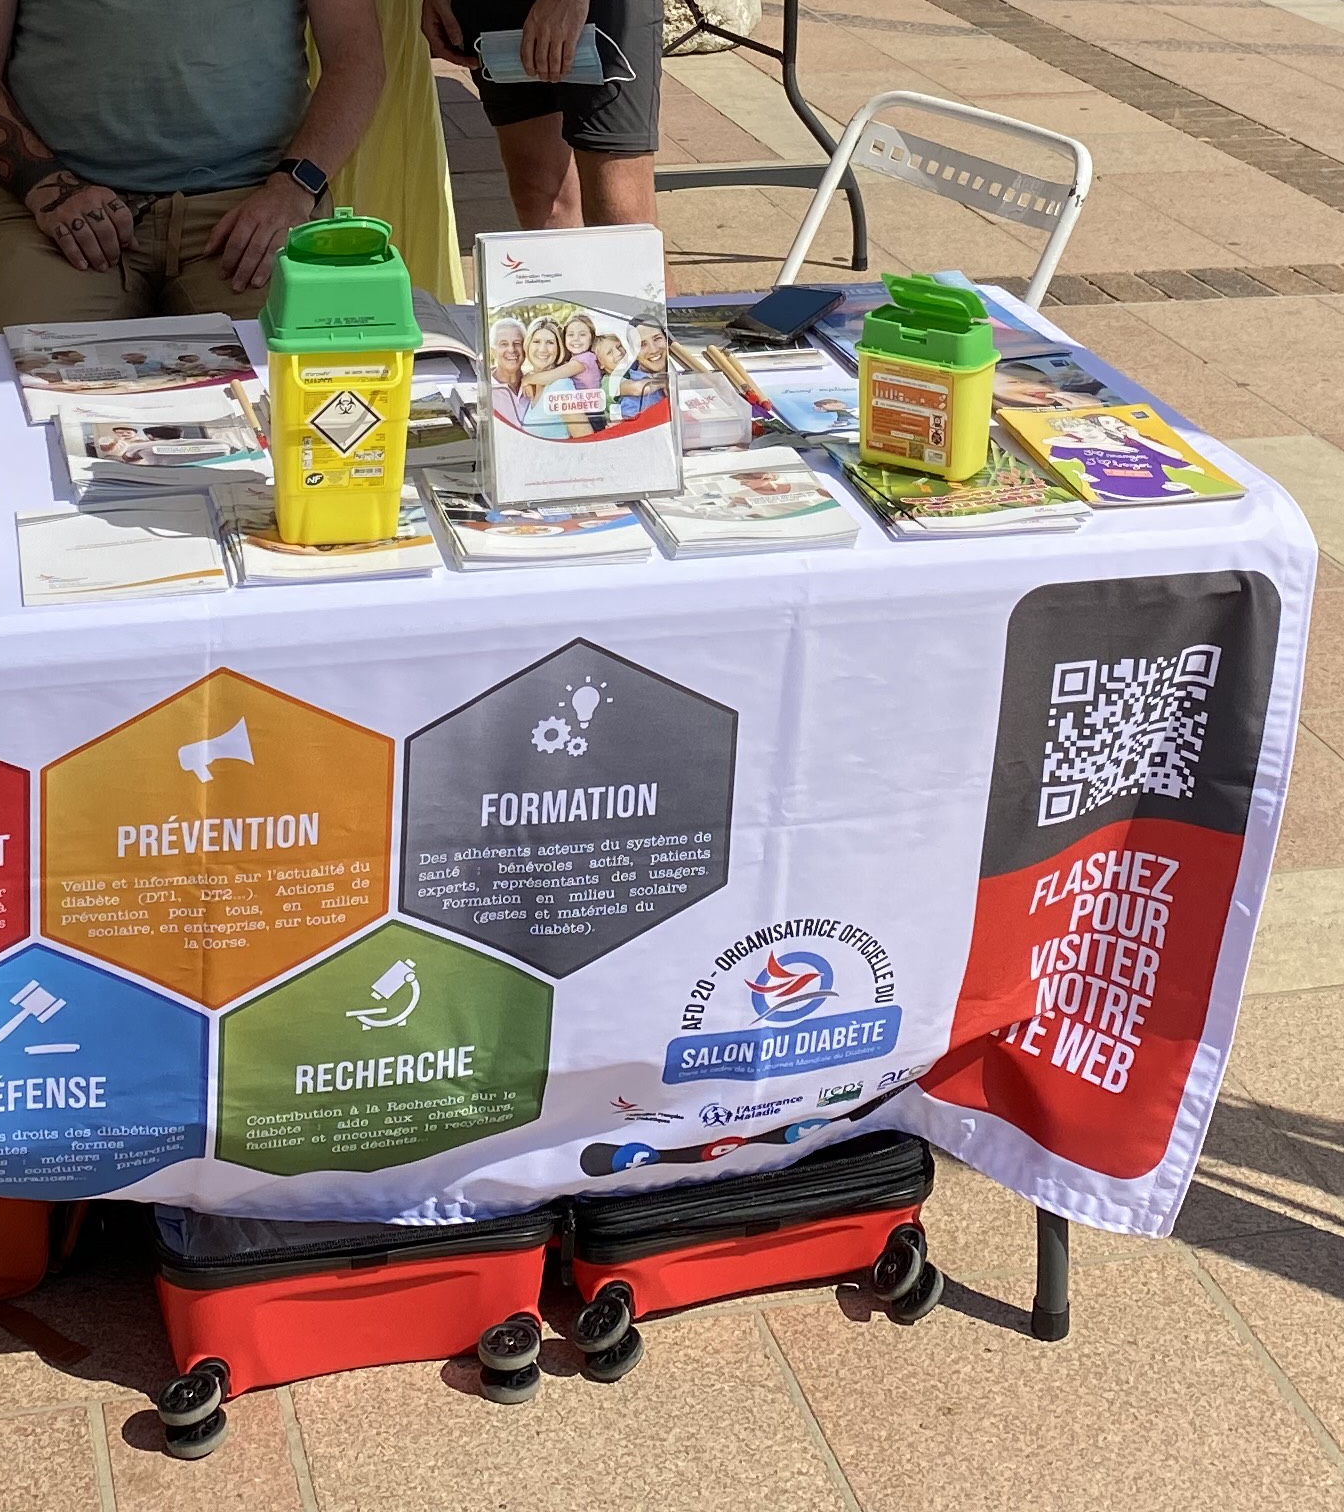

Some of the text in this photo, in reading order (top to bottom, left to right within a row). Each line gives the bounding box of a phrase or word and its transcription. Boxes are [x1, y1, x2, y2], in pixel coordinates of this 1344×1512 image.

[481, 783, 657, 827] FORMATION
[118, 810, 319, 857] PRÉVENTION
[419, 831, 712, 865] Des adhérents acteurs du système de
[418, 848, 711, 882] santé bénévoles actifs, patients
[418, 866, 709, 897] experts, représentants des usagers.
[1029, 849, 1180, 916] FLASHEZ
[442, 883, 687, 910] Formation en milieu scolaire
[473, 900, 654, 924] (gestes et matériels du
[530, 920, 596, 936] diabète).
[1068, 891, 1170, 949] POUR
[681, 918, 895, 1030] AFD 20 ORGANISATRICE OFFICIELLE DU
[1030, 932, 1160, 997] VISITER
[1035, 972, 1152, 1047] NOTRE
[681, 1042, 754, 1069] SALON
[761, 1035, 790, 1062] DU
[795, 1020, 886, 1055] DIABÈTE
[1051, 1017, 1136, 1094] WEB
[296, 1045, 475, 1094] RECHERCHE
[734, 1106, 782, 1123] Maladie
[736, 1095, 804, 1114] l'Assurance
